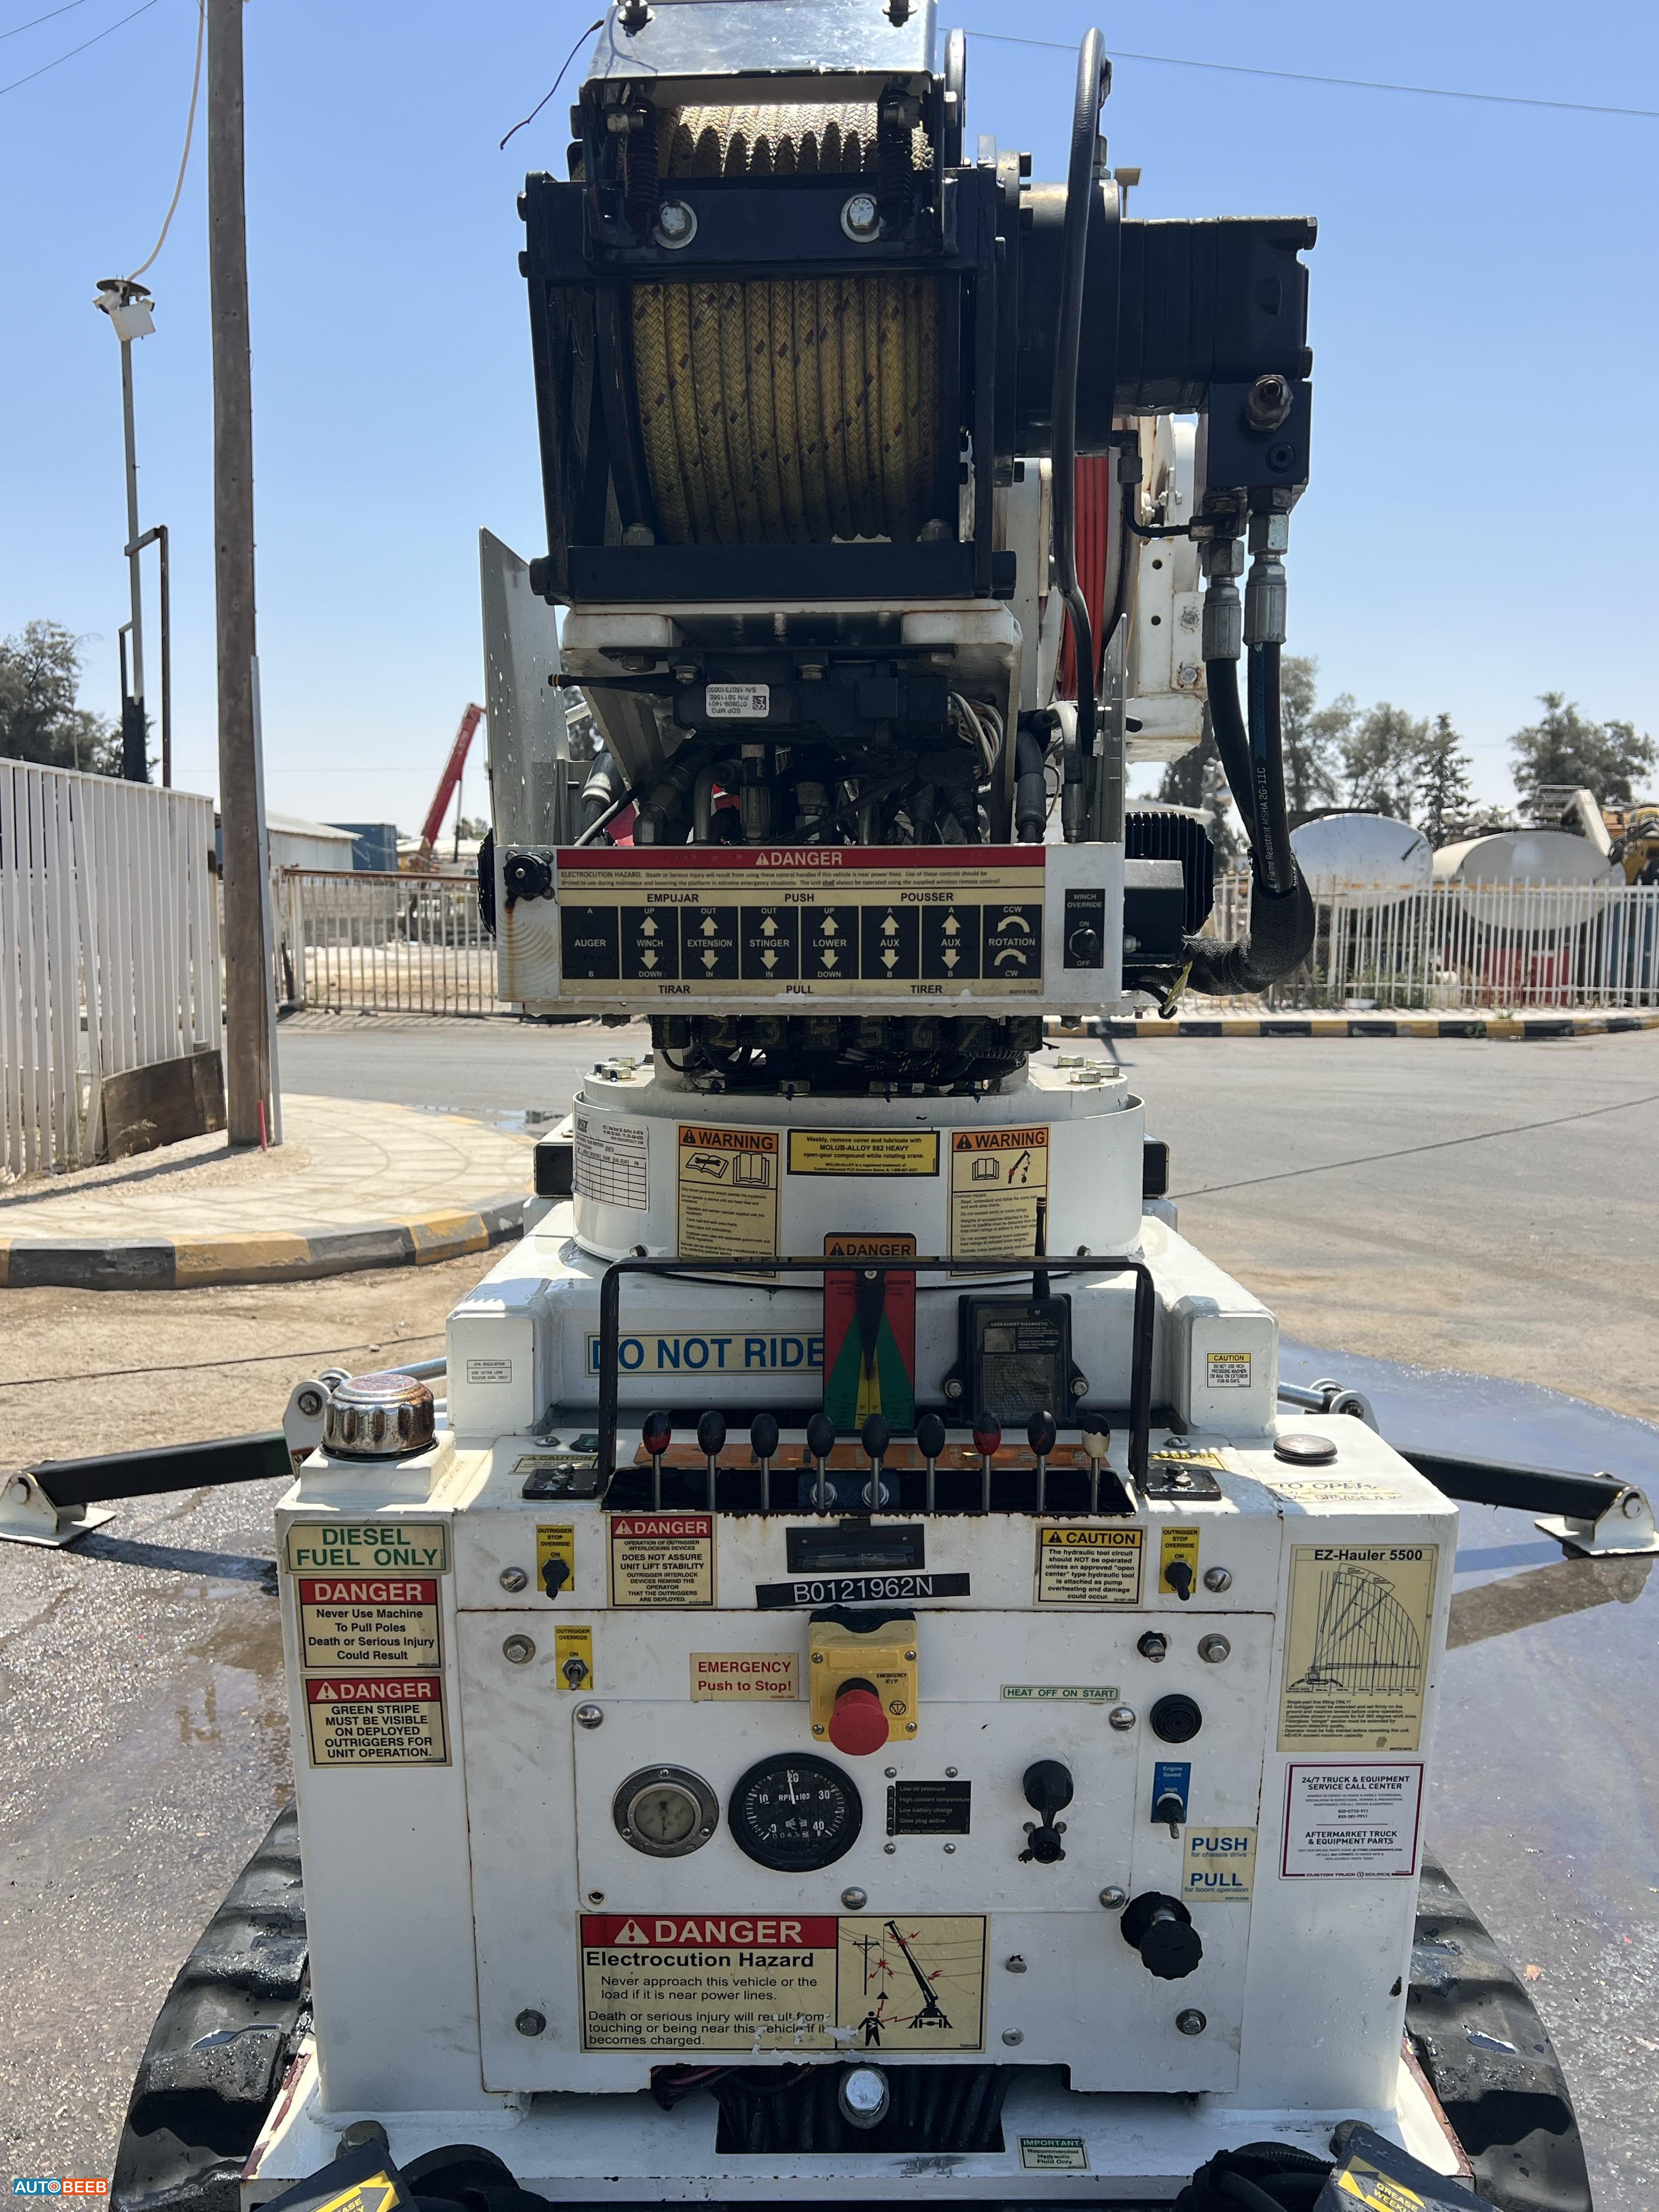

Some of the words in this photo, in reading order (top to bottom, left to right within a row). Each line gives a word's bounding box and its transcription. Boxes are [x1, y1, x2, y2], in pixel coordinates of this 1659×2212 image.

[1257, 768, 1267, 799] 2G-11C
[1263, 827, 1273, 860] Resistant
[771, 851, 842, 866] DANGER
[647, 893, 699, 902] EMPUJAR
[785, 893, 814, 902] PUSH
[901, 892, 953, 902] POUSSER
[636, 939, 663, 947] WINCH
[687, 939, 732, 947] EXTENSION
[749, 939, 789, 947] STINGER
[812, 939, 847, 947] LOWER
[880, 939, 900, 947] AUX
[988, 938, 1035, 946] ROTATION
[658, 985, 691, 994] TIRAR
[786, 985, 814, 994] PULL
[910, 985, 943, 994] TIRER
[698, 1131, 773, 1151] WARNING
[974, 1131, 1045, 1148] WARNING
[847, 1244, 911, 1256] DANGER
[657, 1338, 732, 1369] NOT
[744, 1337, 824, 1369] RIDE
[634, 1521, 707, 1534] DANGER
[322, 1528, 411, 1545] DIESEL
[1066, 1532, 1136, 1544] CAUTION
[296, 1549, 360, 1566] FUEL
[374, 1548, 438, 1566] ONLY
[1314, 1549, 1386, 1561] EZ-Hauler
[1389, 1549, 1423, 1561] 5500
[314, 1583, 422, 1601] DANGER
[793, 1577, 934, 1603] B0121962N
[317, 1609, 349, 1618] Never
[352, 1609, 373, 1618] Use
[376, 1609, 423, 1618] Machine
[335, 1622, 348, 1632] To
[351, 1623, 372, 1632] Pull
[375, 1623, 406, 1632] Poles
[308, 1637, 340, 1646] Death
[358, 1637, 400, 1646] Serious
[403, 1637, 435, 1648] Injury
[337, 1650, 370, 1660] Could
[373, 1651, 408, 1660] Result
[698, 1661, 792, 1673] EMERGENCY
[340, 1683, 431, 1699] DANGER
[698, 1680, 732, 1691] Push
[737, 1681, 751, 1691] to
[755, 1680, 791, 1694] Stop!
[1082, 1690, 1114, 1698] START
[331, 1705, 374, 1715] GREEN
[377, 1705, 420, 1714] STRIPE
[325, 1717, 359, 1726] MUST
[363, 1716, 379, 1725] BE
[381, 1716, 428, 1725] VISIBLE
[335, 1728, 353, 1736] ON
[357, 1726, 420, 1736] DEPLOYED
[325, 1737, 404, 1748] OUTRIGGERS
[408, 1737, 432, 1746] FOR
[327, 1749, 356, 1758] UNIT
[359, 1748, 432, 1759] OPERATION.
[819, 1790, 831, 1800] 30
[812, 1821, 825, 1831] 40
[1192, 1837, 1248, 1852] PUSH
[1190, 1873, 1243, 1887] PULL
[655, 1921, 803, 1943] DANGER
[586, 1951, 731, 1967] Electrocution
[739, 1953, 814, 1967] Hazard
[601, 1976, 640, 1986] Never
[643, 1977, 702, 1988] approach
[707, 1977, 729, 1987] this
[732, 1977, 777, 1987] vehicle
[798, 1977, 817, 1987] the
[601, 1989, 628, 2000] load
[633, 1989, 640, 1999] if
[644, 1990, 651, 1999] it
[654, 1990, 664, 2000] is
[701, 1992, 740, 2002] power
[744, 1990, 776, 2000] lines.
[589, 2011, 626, 2021] Death
[647, 2012, 692, 2021] serious
[697, 2012, 730, 2024] injury
[733, 2012, 753, 2022] will
[589, 2036, 646, 2045] becomes
[651, 2036, 704, 2047] charged.
[1376, 2183, 1419, 2212] GREASE
